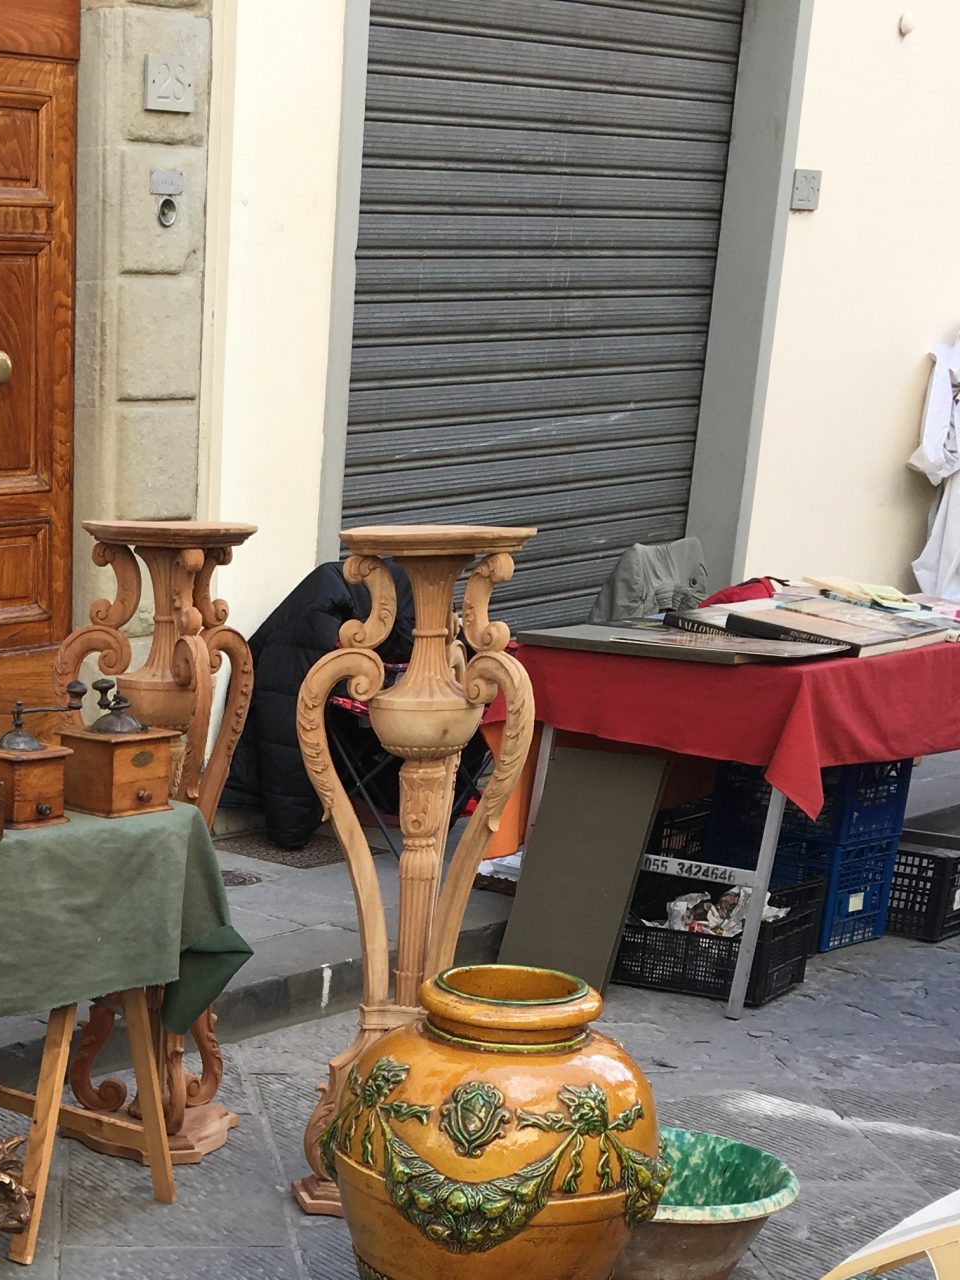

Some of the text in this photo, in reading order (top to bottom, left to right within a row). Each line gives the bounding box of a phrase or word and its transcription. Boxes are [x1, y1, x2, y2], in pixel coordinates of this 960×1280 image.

[156, 63, 185, 101] 28
[644, 857, 736, 882] 055 3424646
